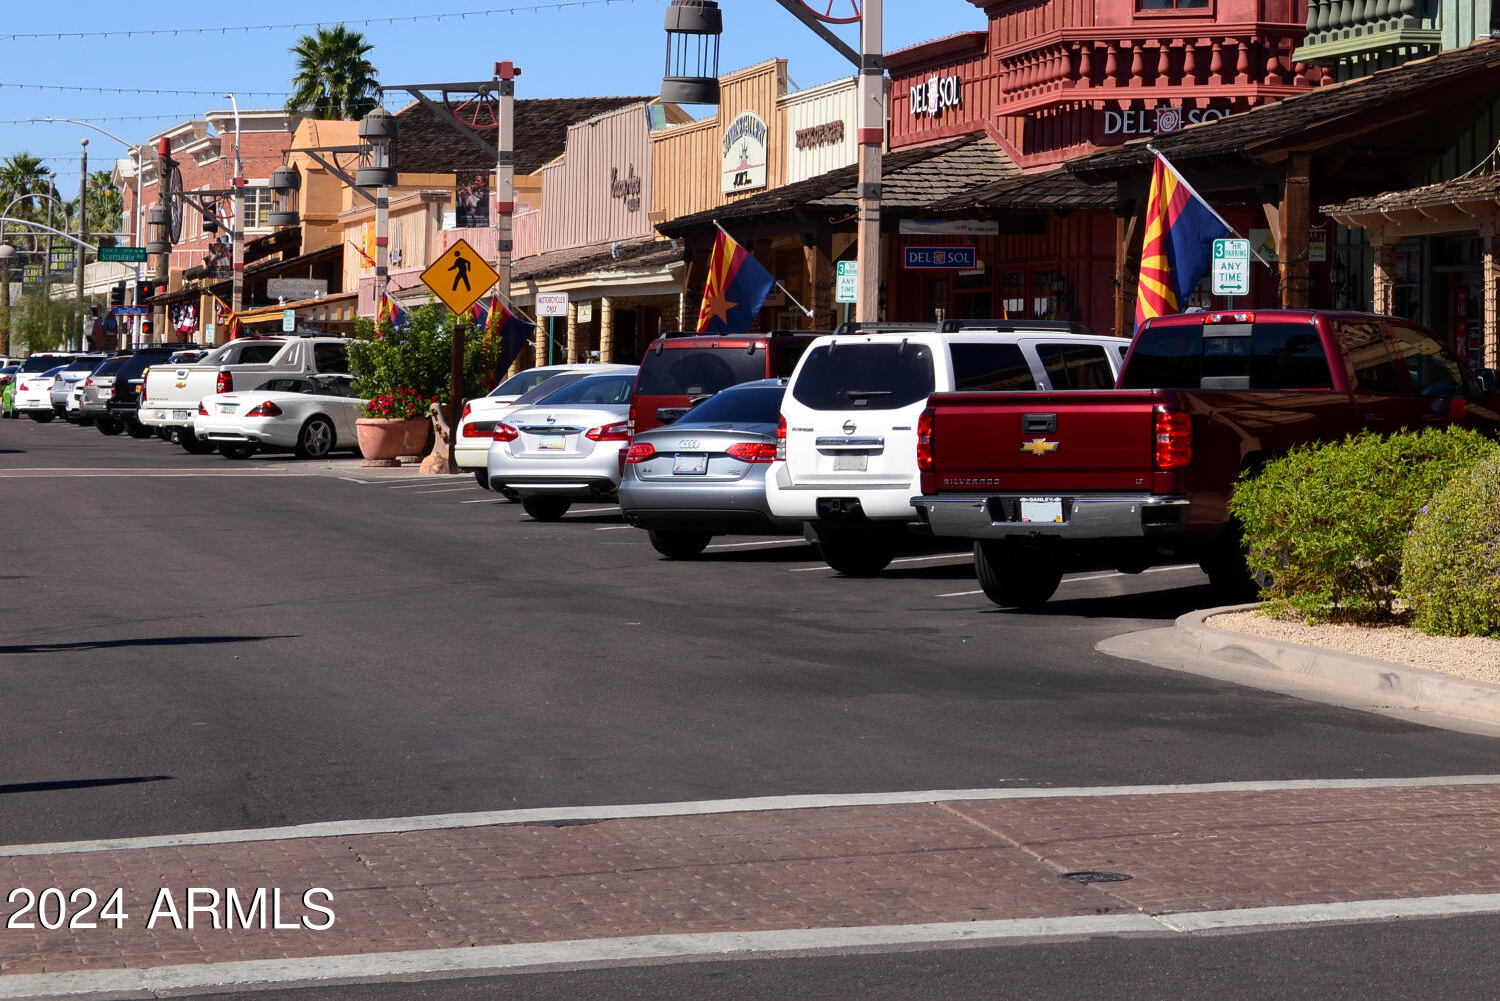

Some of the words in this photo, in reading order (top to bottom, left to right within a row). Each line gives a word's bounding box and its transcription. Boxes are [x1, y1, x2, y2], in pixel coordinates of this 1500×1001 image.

[910, 83, 928, 114] DEL
[939, 75, 959, 108] SOL
[1104, 110, 1152, 134] DEL
[1215, 243, 1224, 257] 3
[1225, 249, 1247, 258] PARKING
[909, 252, 931, 263] DEL
[947, 252, 970, 263] SOL
[838, 264, 844, 275] 3
[1220, 262, 1241, 271] ANY
[1220, 273, 1242, 282] TIME
[538, 296, 566, 304] MOTORCYCLES
[546, 305, 557, 313] ONLY
